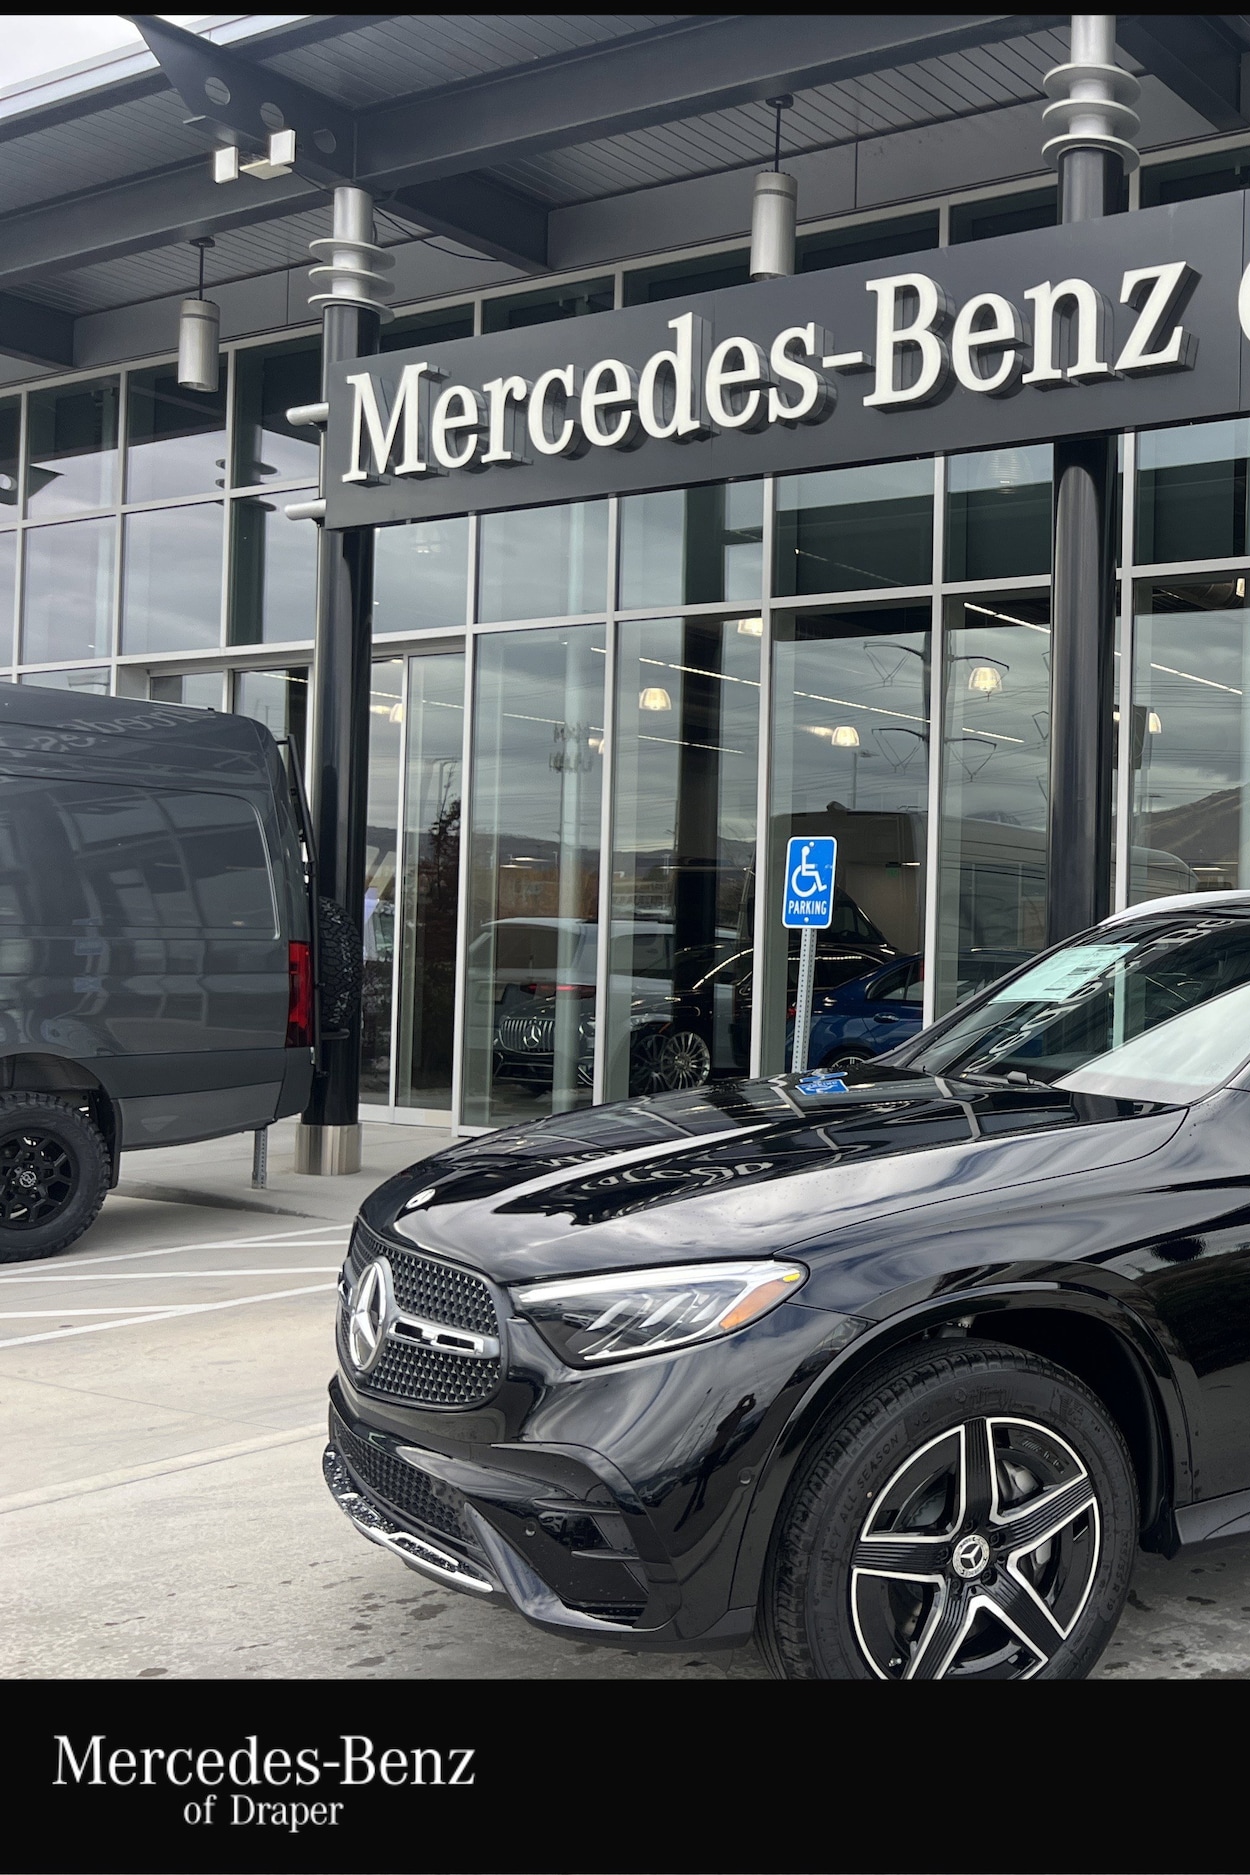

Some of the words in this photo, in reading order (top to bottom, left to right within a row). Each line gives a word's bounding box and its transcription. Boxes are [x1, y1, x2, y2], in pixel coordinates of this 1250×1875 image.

[343, 262, 1190, 484] Mercedes-Benz
[788, 900, 827, 915] PARKING
[840, 1494, 858, 1524] ALL
[857, 1434, 899, 1490] SEASON
